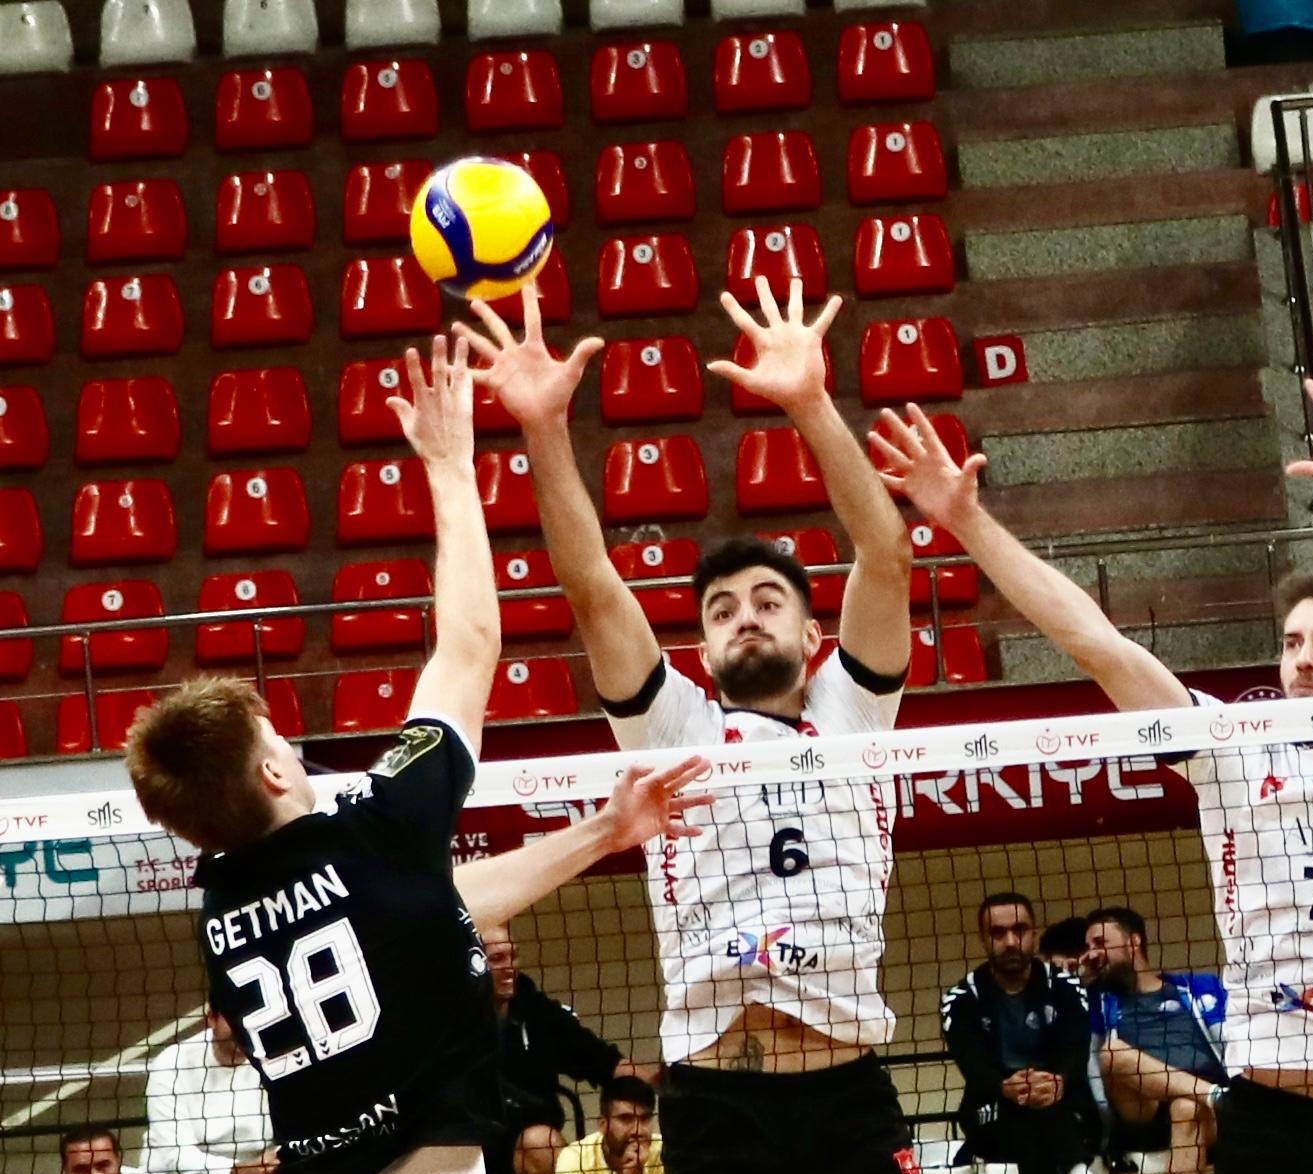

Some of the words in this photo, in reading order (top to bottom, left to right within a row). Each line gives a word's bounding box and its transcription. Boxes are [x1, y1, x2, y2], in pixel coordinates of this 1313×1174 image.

[985, 345, 1017, 379] D
[13, 815, 49, 830] TVF
[87, 801, 123, 828] SMS
[542, 775, 577, 790] TVF
[717, 761, 752, 775] TVF
[790, 748, 825, 772] SMS
[891, 747, 927, 761] TVF
[964, 734, 999, 758] SMS
[1064, 733, 1100, 747] TVF
[1137, 719, 1173, 744] SMS
[1238, 719, 1273, 733] TVF
[769, 827, 809, 878] 6
[205, 863, 350, 956] GETMAN
[226, 917, 381, 1080] 28
